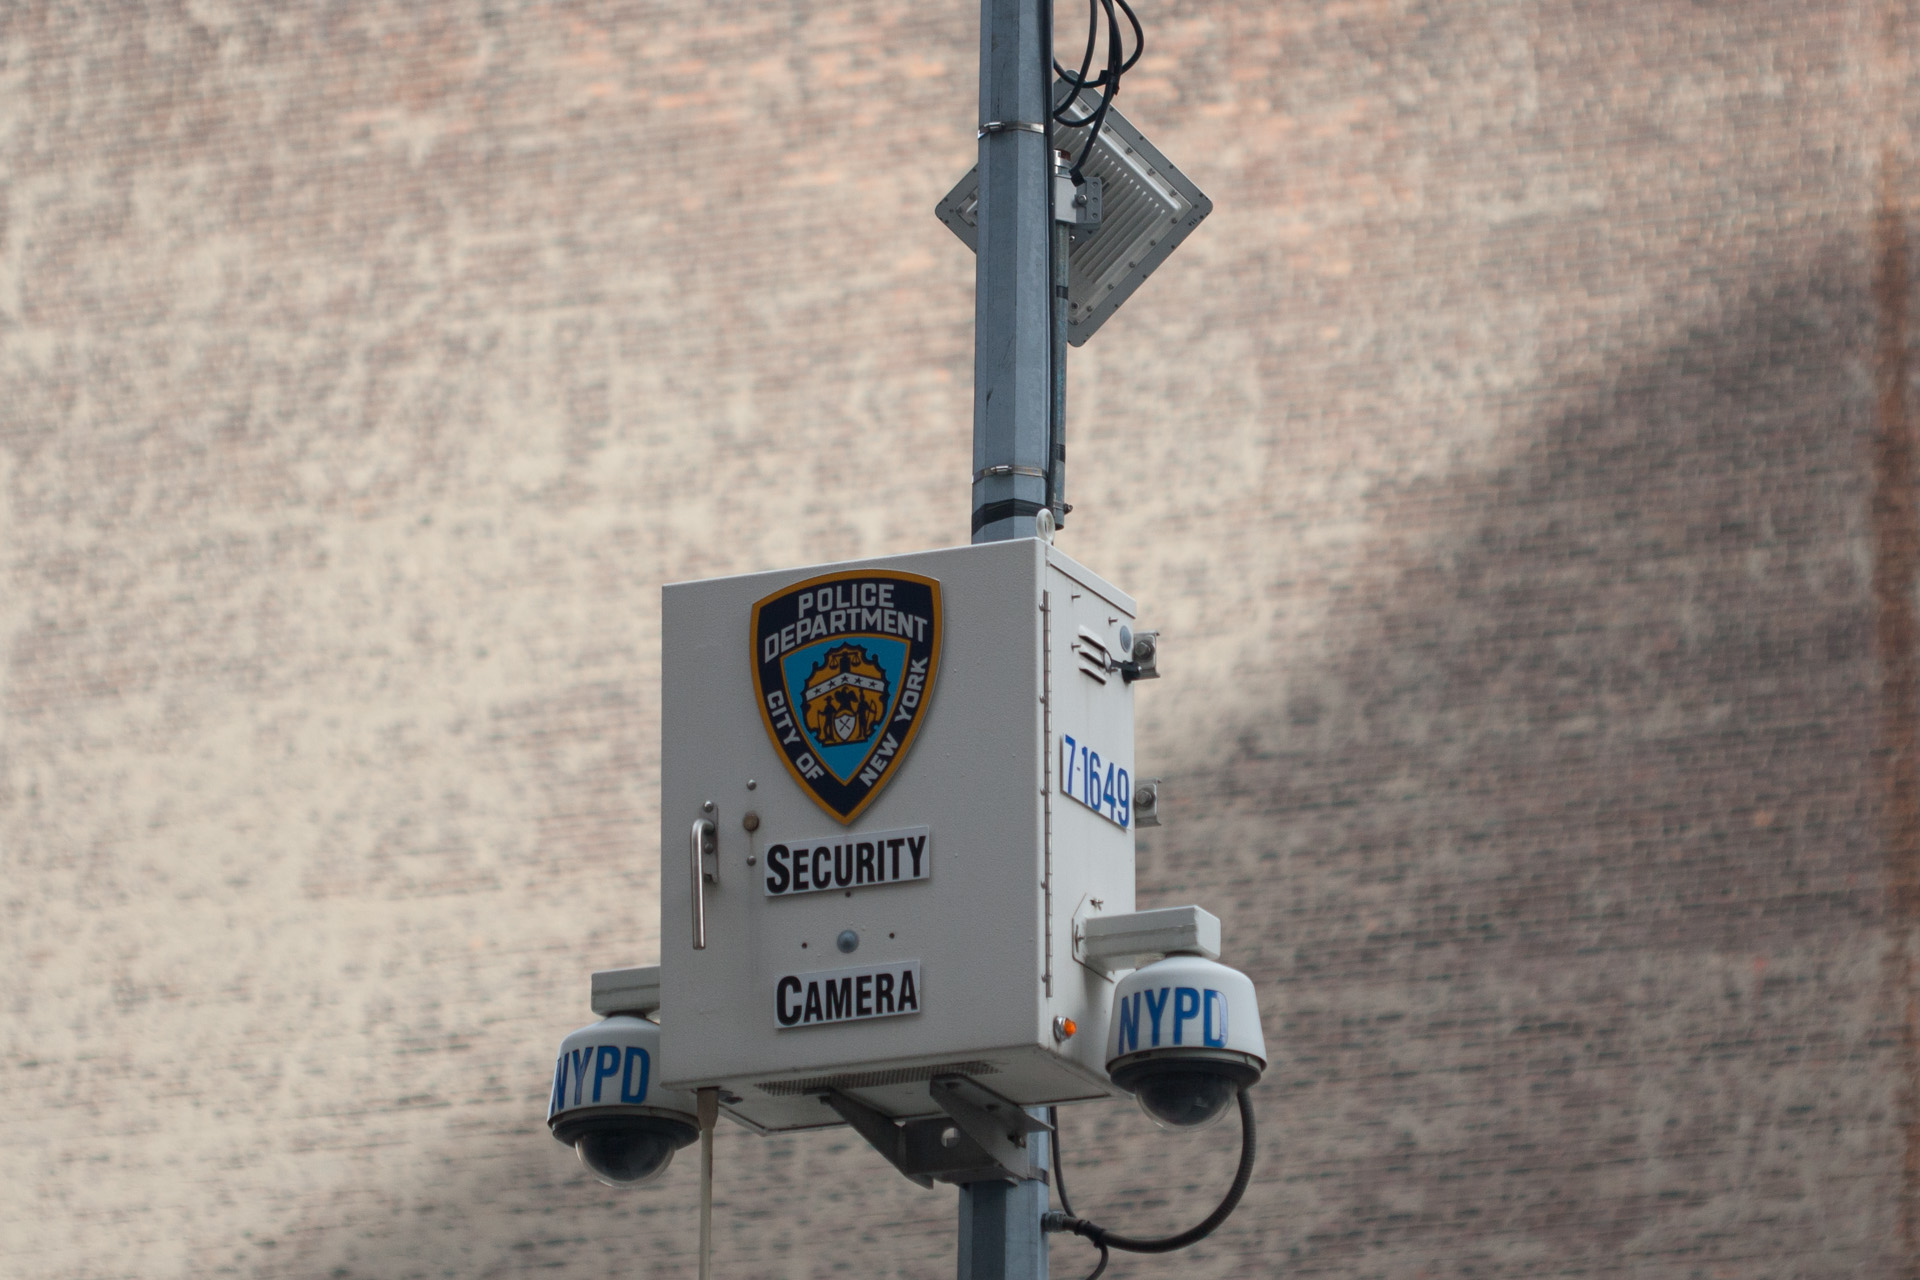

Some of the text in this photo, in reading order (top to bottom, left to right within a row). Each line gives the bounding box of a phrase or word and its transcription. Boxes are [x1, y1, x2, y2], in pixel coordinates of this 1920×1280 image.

[798, 583, 895, 619] POLICE
[764, 608, 928, 664] DEPARTMENT
[766, 657, 928, 788] CITY OF NEW YORK
[1065, 734, 1130, 828] 7-1649
[766, 835, 927, 894] SECURITY
[776, 970, 919, 1026] CAMERA
[1118, 986, 1228, 1056] NYPD
[551, 1045, 650, 1116] NYPD
